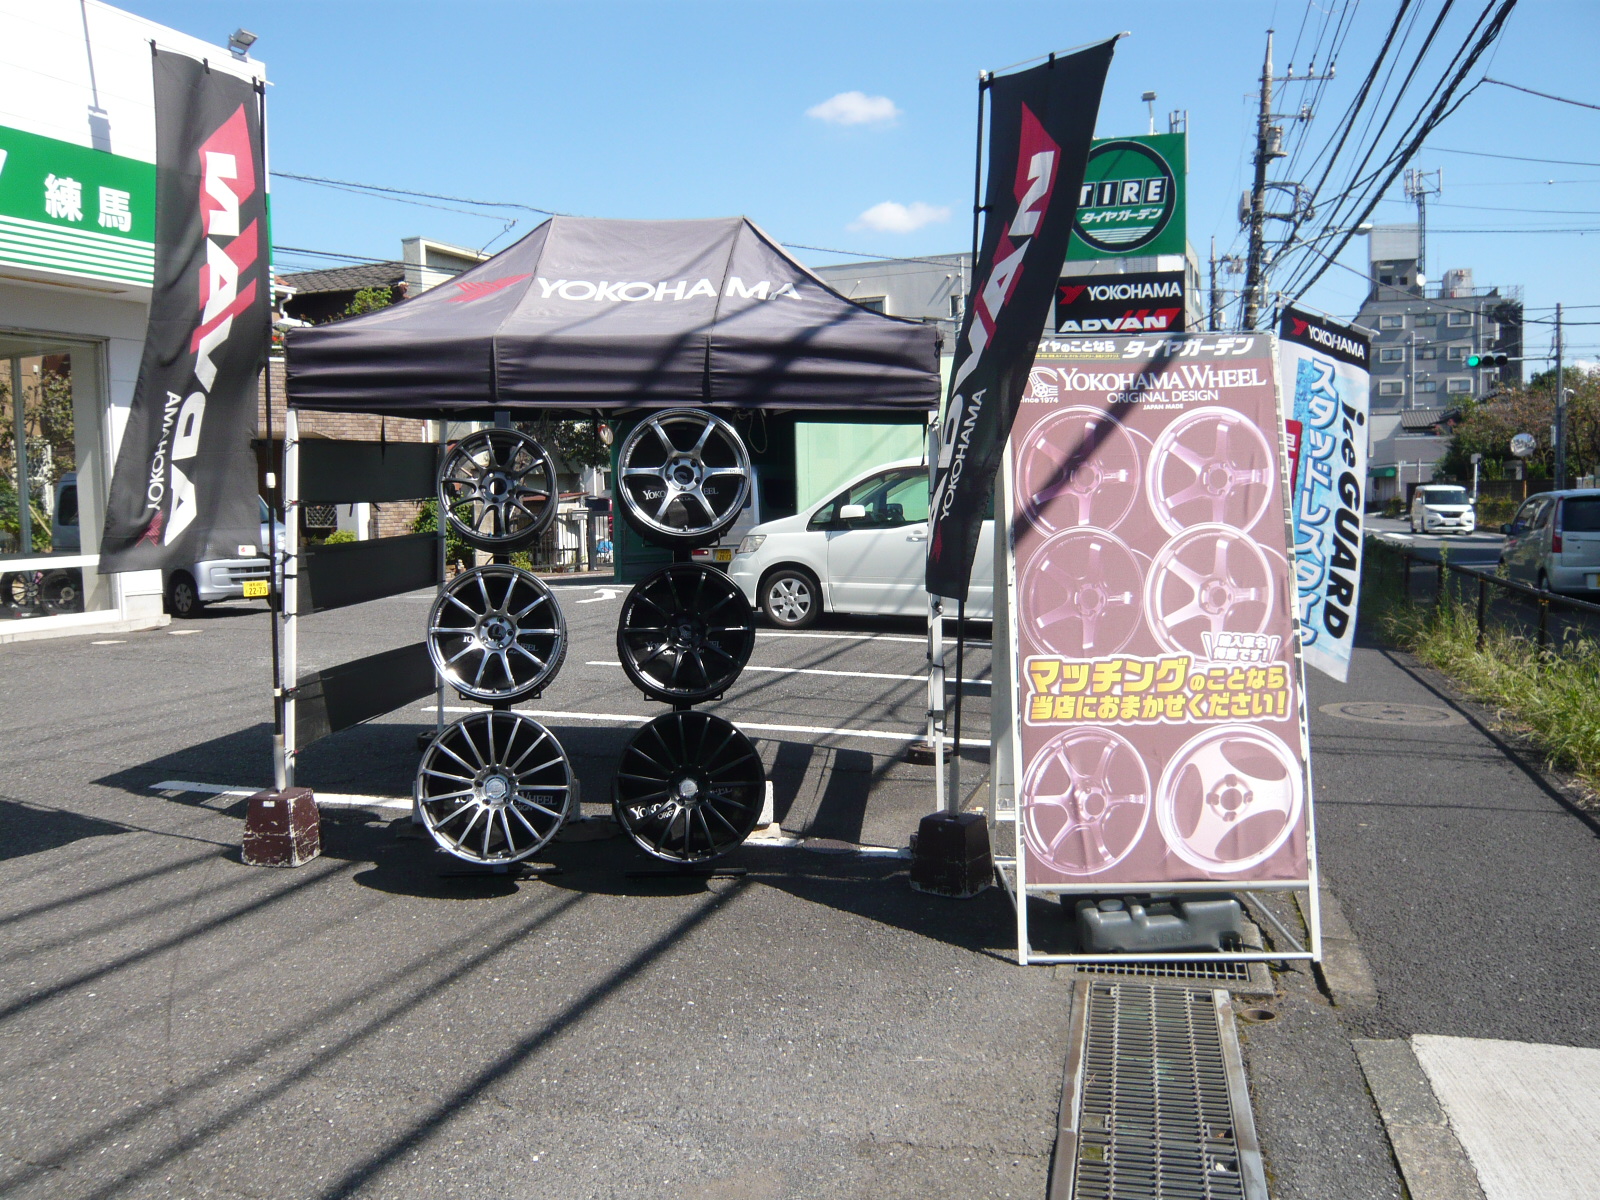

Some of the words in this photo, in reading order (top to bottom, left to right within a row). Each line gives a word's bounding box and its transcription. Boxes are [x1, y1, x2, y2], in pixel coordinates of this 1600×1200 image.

[44, 173, 132, 232] 練馬
[1079, 180, 1162, 206] TIRE
[1080, 207, 1163, 224] タイヤガーデン
[537, 276, 802, 301] YOKOHAMA
[1087, 282, 1182, 301] YOKOHAMA
[1059, 316, 1167, 333] ADVAN
[1037, 340, 1117, 353] イヤのことなら
[1122, 337, 1254, 359] タイヤガーデン
[1308, 324, 1365, 360] YOKOHAMA
[1057, 367, 1185, 391] YOKOHAMA
[1179, 364, 1267, 389] WHEEL
[1021, 395, 1039, 404] ince
[1041, 396, 1059, 404] 1974
[1106, 391, 1169, 404] ORIGINAL
[1171, 389, 1219, 402] DESIGN
[940, 388, 987, 521] YOKOHAMA
[1324, 400, 1365, 639] iceGUARD
[1030, 657, 1285, 693] マッチングのことなら
[1031, 691, 1286, 720] 当店におまかせください!
